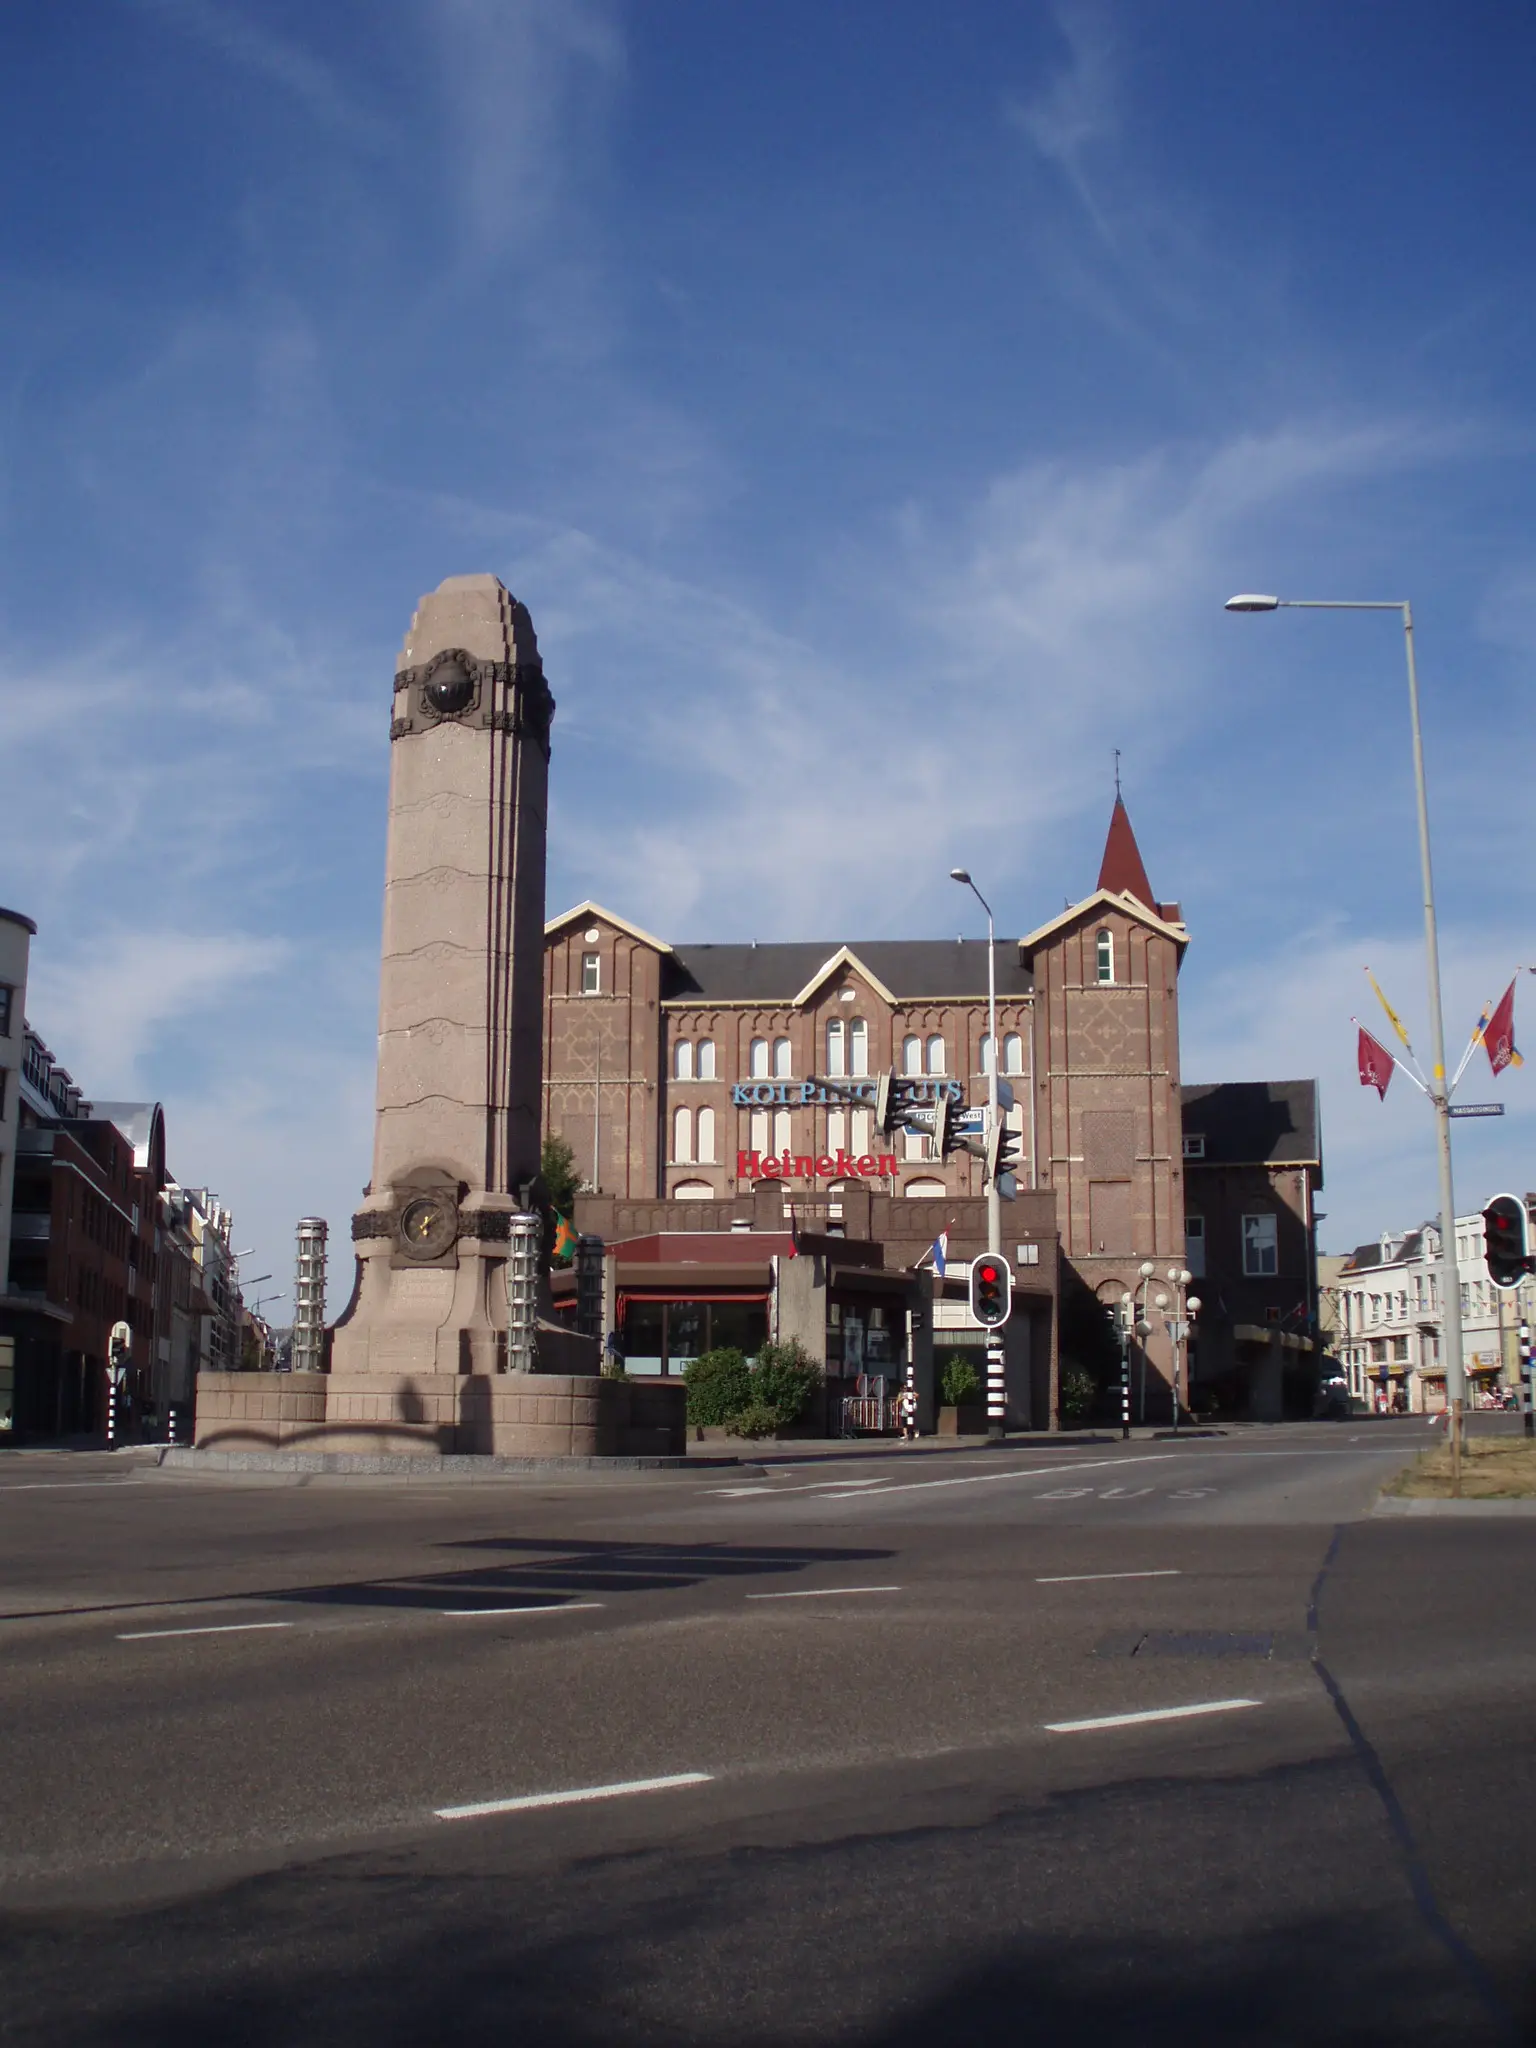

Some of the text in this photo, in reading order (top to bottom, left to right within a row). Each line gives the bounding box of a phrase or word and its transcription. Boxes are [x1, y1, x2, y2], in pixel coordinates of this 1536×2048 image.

[732, 1079, 962, 1104] KOLPIGUIS
[961, 1112, 981, 1120] West
[736, 1148, 900, 1178] Heineken
[1031, 1487, 1219, 1499] BUS
